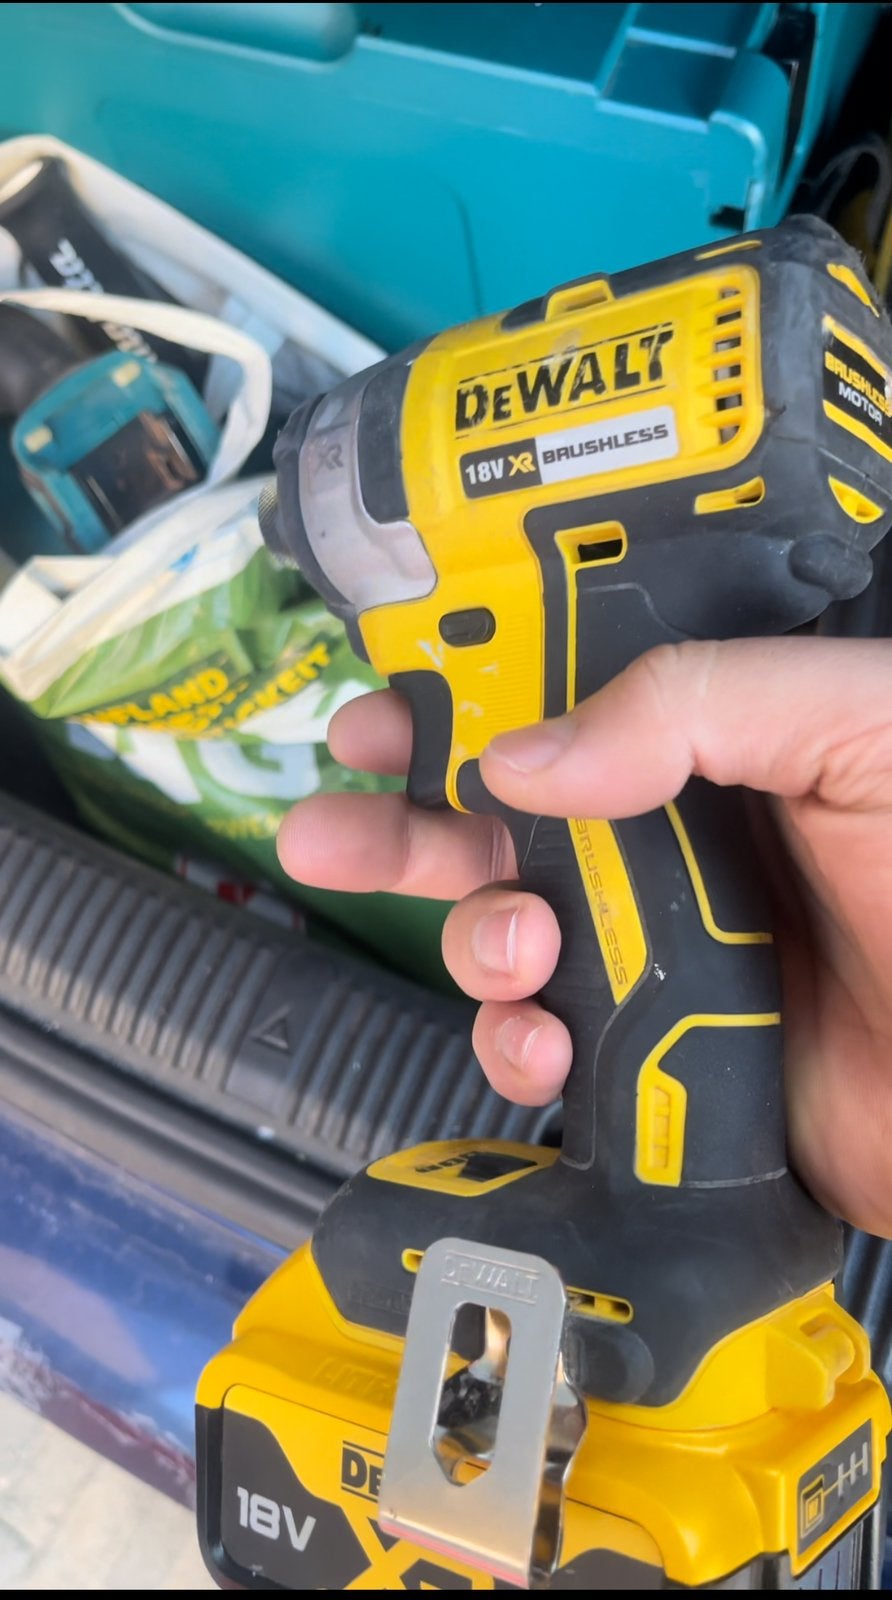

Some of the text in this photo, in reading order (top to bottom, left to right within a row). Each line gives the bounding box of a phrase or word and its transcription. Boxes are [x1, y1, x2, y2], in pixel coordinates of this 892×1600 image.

[455, 329, 674, 432] DEWALT
[838, 381, 882, 426] MOTOR
[465, 424, 669, 485] 18V XR BRUSHLESS
[575, 818, 629, 986] BRUSHLESS
[237, 1486, 317, 1552] 18V
